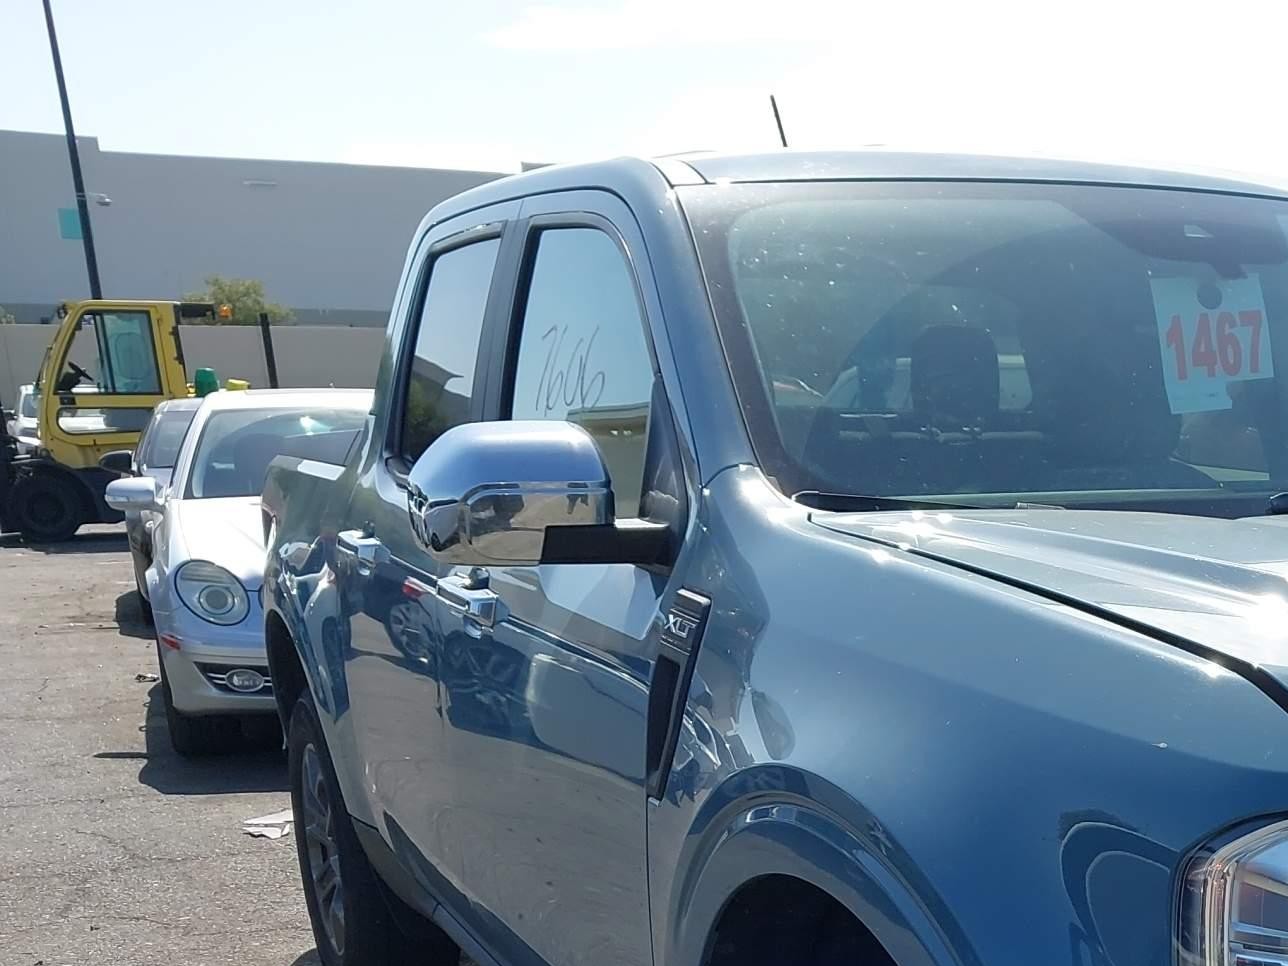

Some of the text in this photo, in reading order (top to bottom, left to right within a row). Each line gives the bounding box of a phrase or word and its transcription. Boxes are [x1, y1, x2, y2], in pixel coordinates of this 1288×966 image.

[536, 324, 605, 417] 7606
[1166, 309, 1262, 381] 1467
[663, 613, 697, 638] XLT
